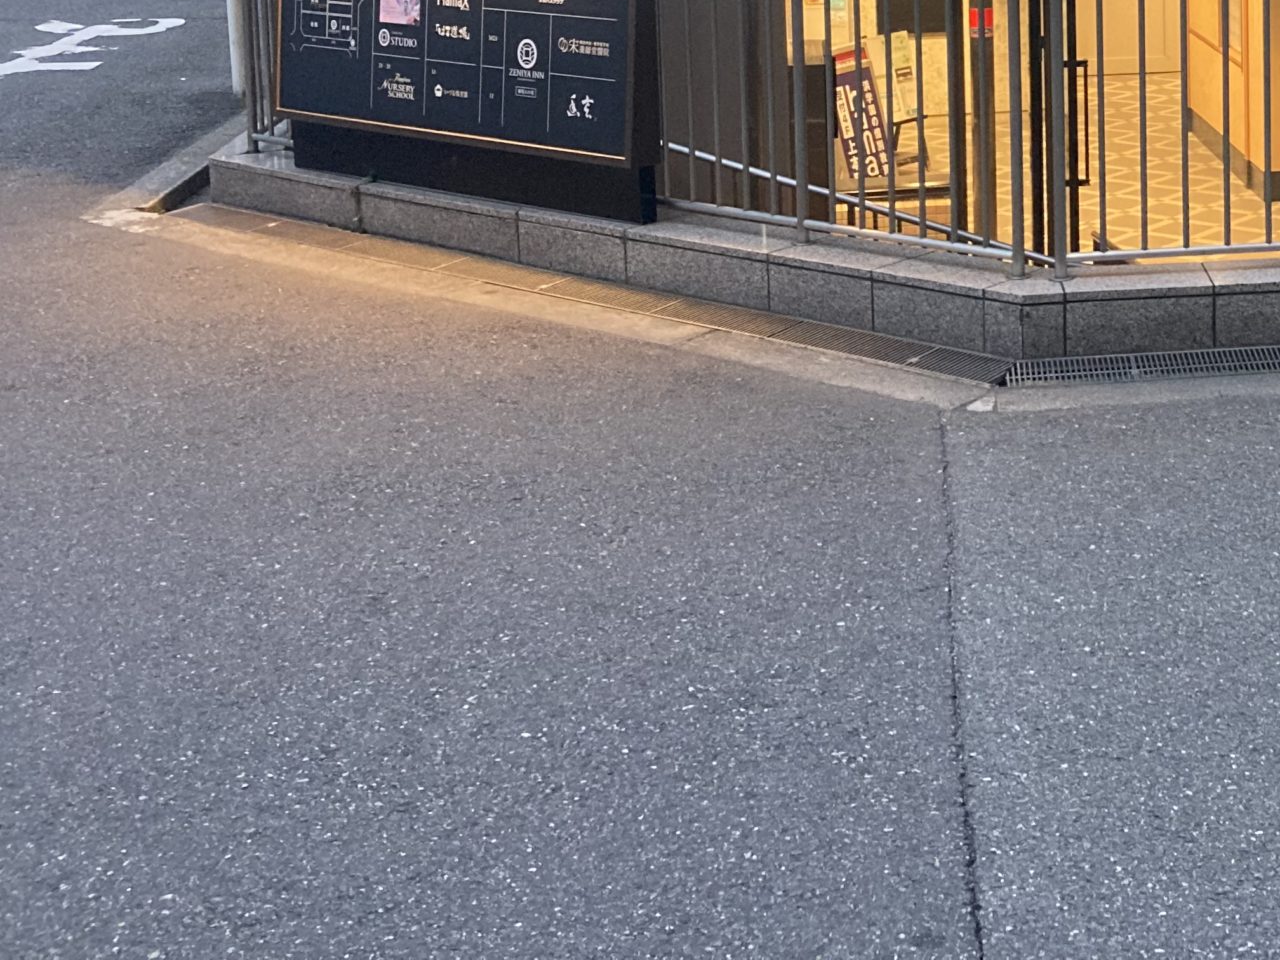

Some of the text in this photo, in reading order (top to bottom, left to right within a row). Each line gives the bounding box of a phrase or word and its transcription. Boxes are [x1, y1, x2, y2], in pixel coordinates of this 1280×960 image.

[390, 36, 418, 48] STUDIO
[508, 68, 532, 79] ZENIYA
[532, 70, 545, 80] INN
[377, 79, 416, 93] NURSERY
[388, 91, 415, 101] SCHOOL
